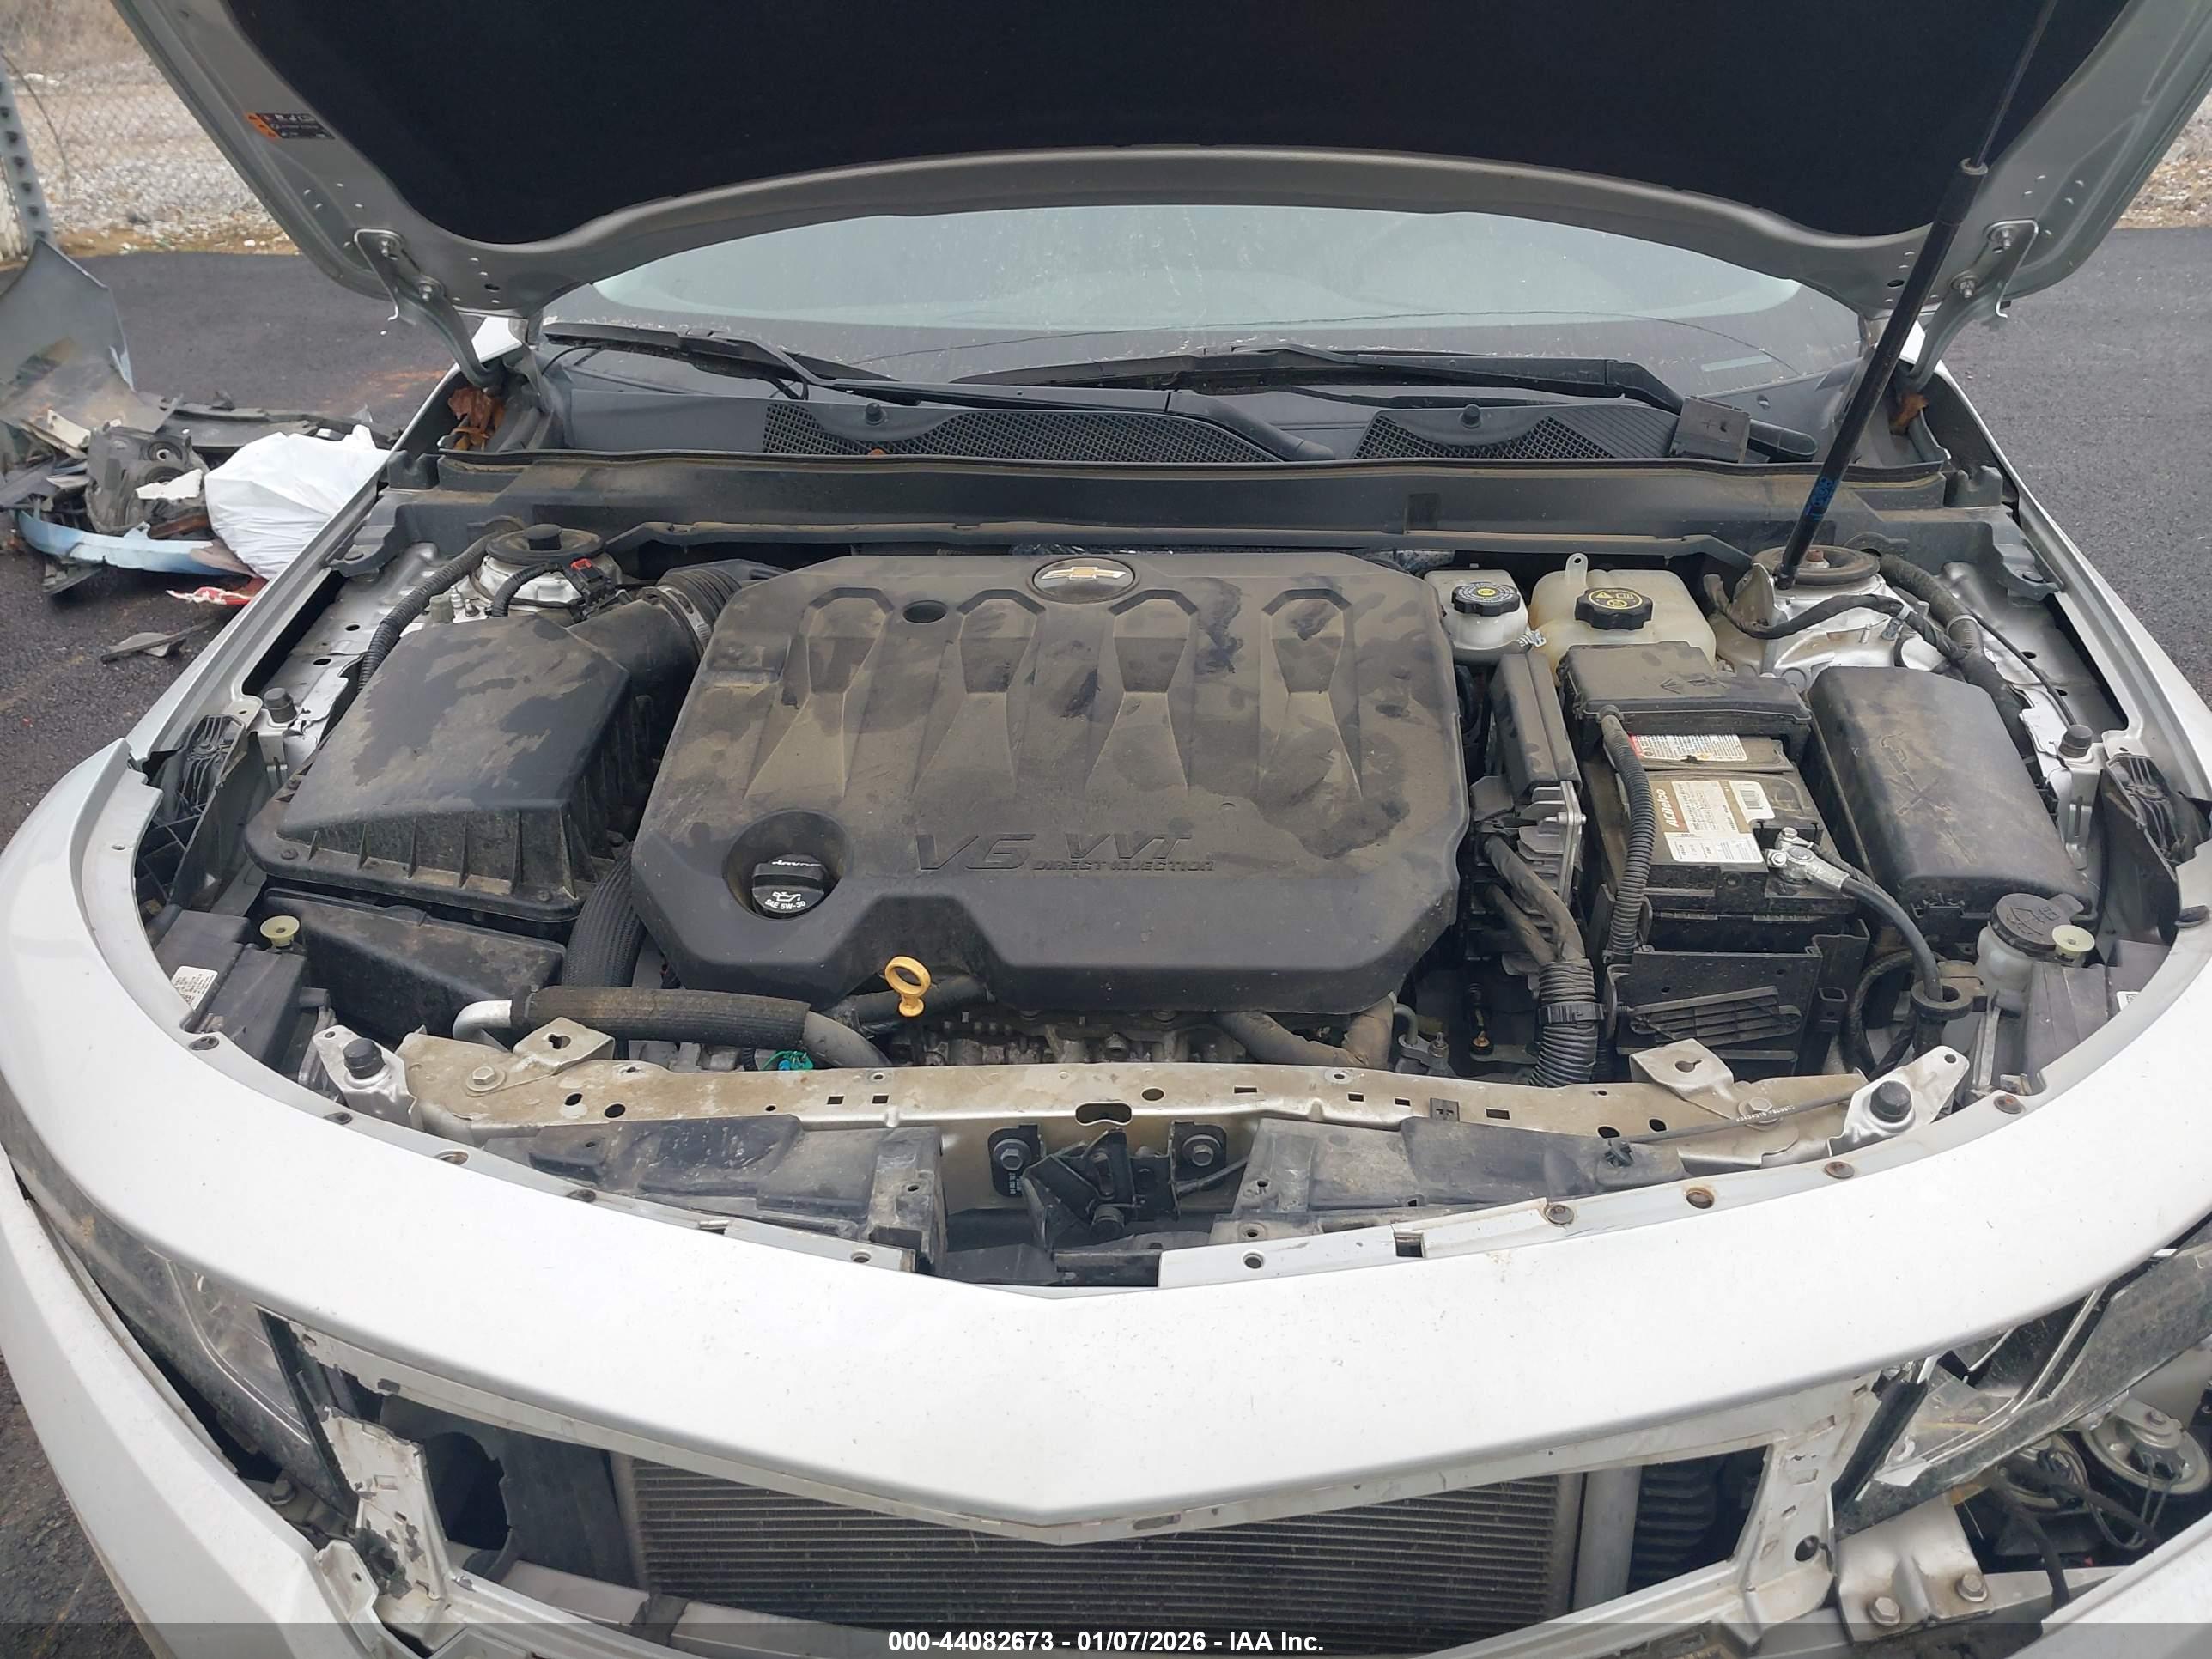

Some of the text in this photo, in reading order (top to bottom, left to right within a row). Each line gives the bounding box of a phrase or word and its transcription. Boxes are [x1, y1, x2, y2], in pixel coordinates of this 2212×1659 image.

[1656, 788, 1680, 829] ACDelco
[914, 833, 1036, 871] V6
[1064, 833, 1193, 860] VVT
[1033, 860, 1215, 872] DIRECT INJECTION
[764, 898, 806, 910] SAE 5W-30
